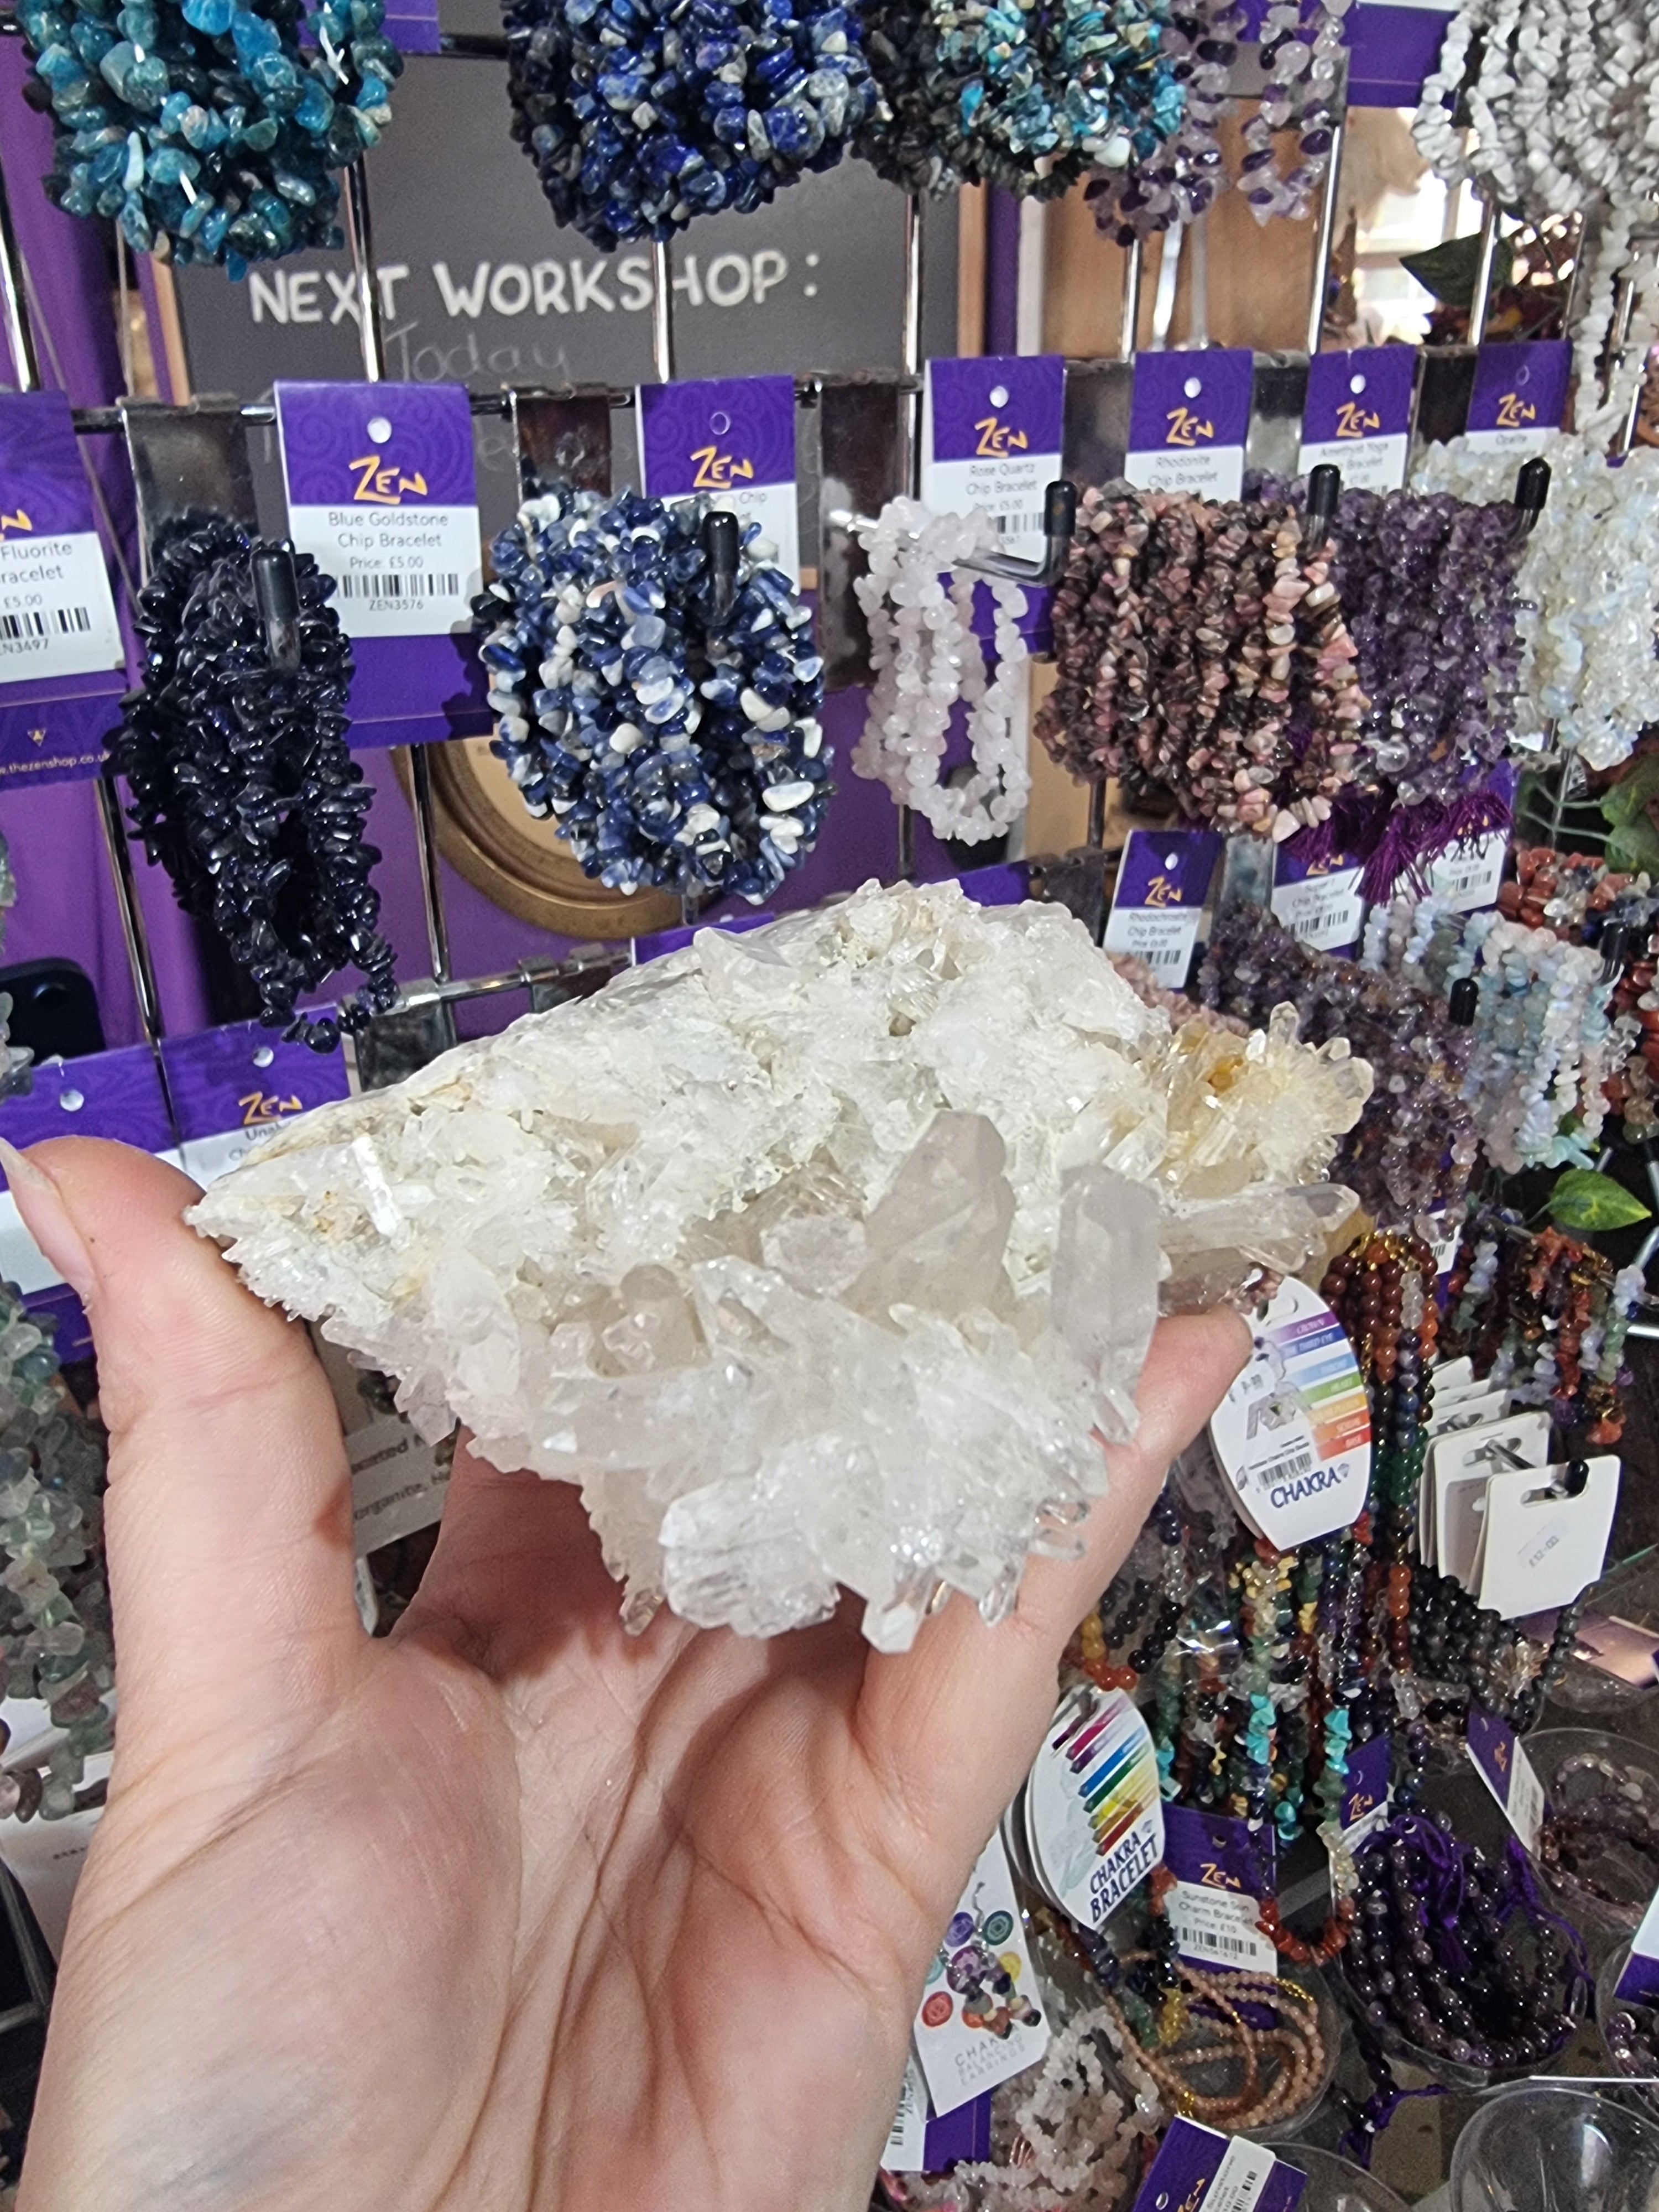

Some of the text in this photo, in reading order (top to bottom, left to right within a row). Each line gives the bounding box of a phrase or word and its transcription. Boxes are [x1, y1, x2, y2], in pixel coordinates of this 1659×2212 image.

[248, 265, 409, 324] NEXT
[386, 321, 570, 384] Today
[1166, 407, 1214, 446] ZEN
[1336, 401, 1380, 437] ZEN
[1496, 392, 1536, 427] ZEN
[975, 417, 1027, 458] ZEN
[349, 455, 427, 505] ZEN
[690, 445, 754, 489] ZEN
[995, 481, 1037, 493] Bracelet
[328, 512, 448, 526] Blue Goldstone
[1, 543, 72, 560] Fluorite
[338, 533, 442, 550] Chip Bracelet
[1, 565, 64, 584] racelet
[390, 556, 424, 569] £5.00
[4, 594, 42, 609] £5.00
[369, 600, 424, 611] ZEN3576
[0, 638, 49, 656] N3497
[1144, 875, 1182, 909] ZEN
[1149, 926, 1181, 936] Bracelet
[238, 1091, 302, 1125] ZEN
[1270, 1467, 1342, 1508] CHAKRA
[1091, 1831, 1141, 1894] CHAKRA
[1091, 1833, 1157, 1923] BRACELET
[1200, 1863, 1241, 1890] ZEN
[955, 2022, 1019, 2066] CHAKA
